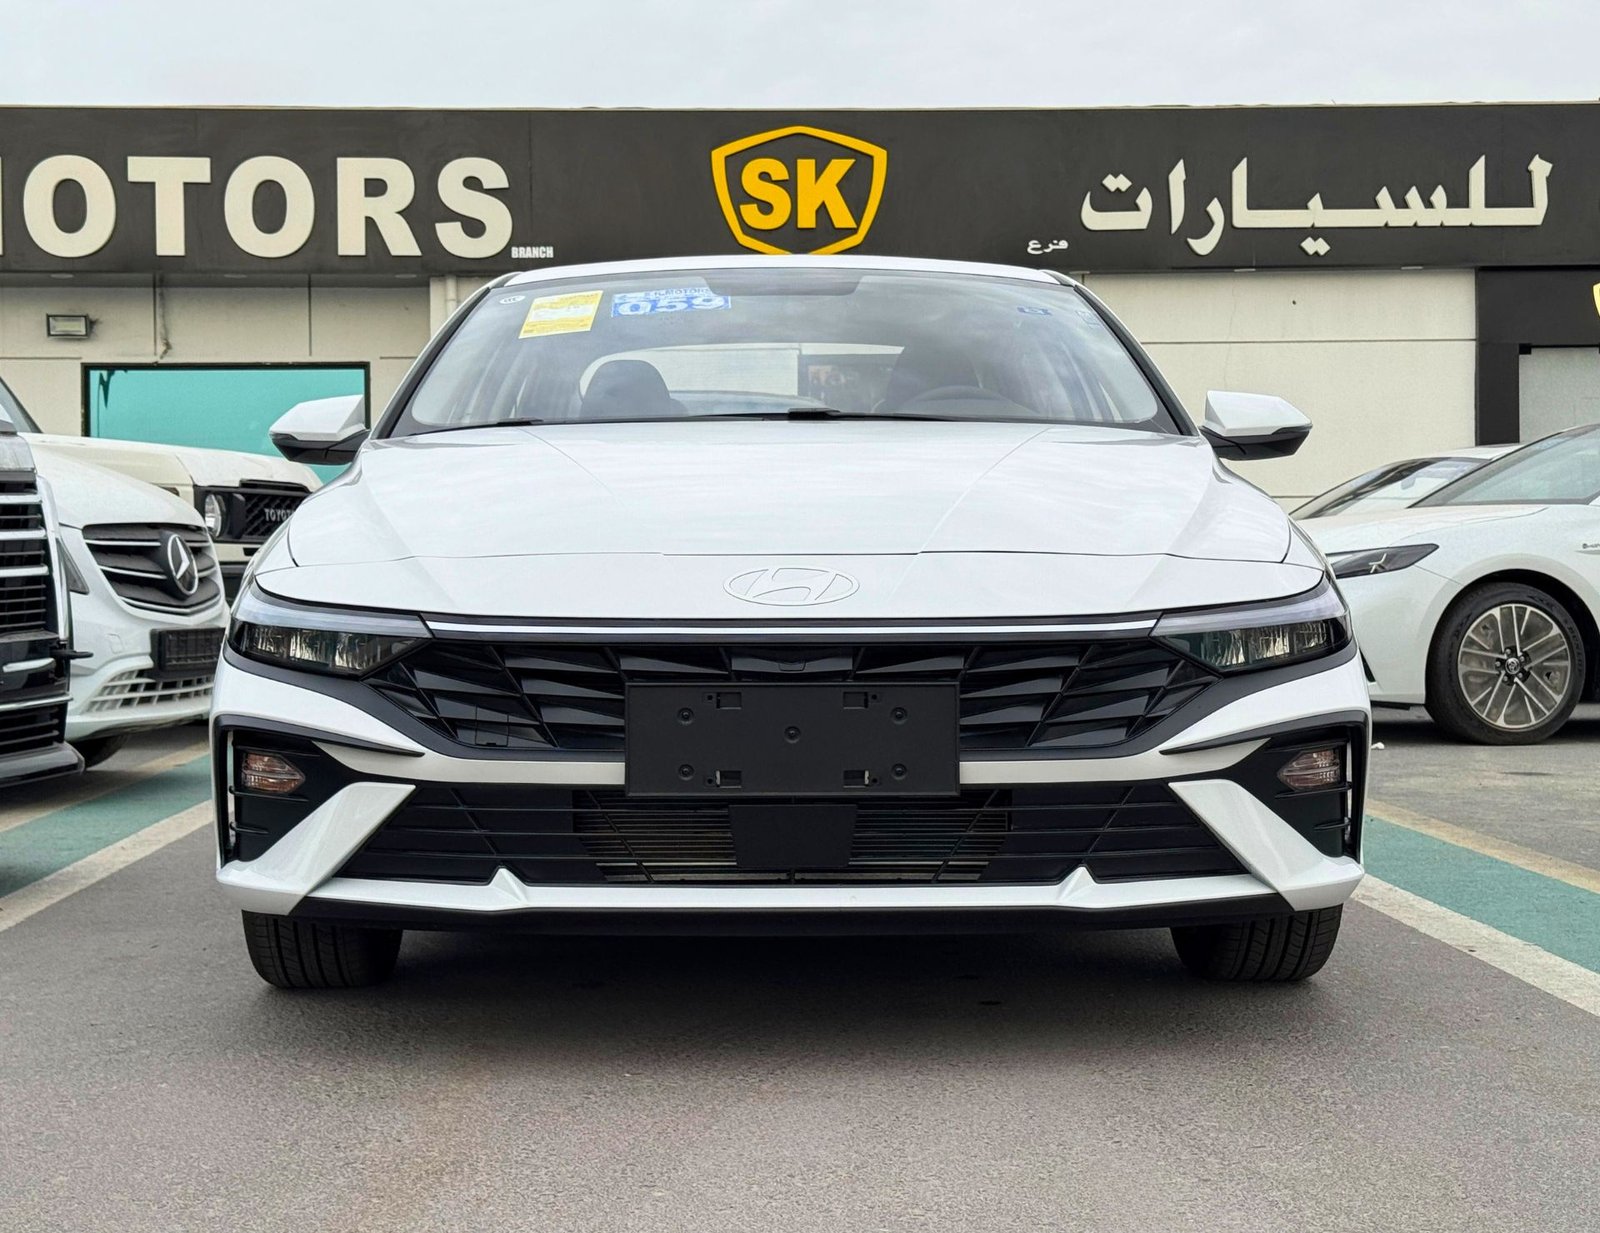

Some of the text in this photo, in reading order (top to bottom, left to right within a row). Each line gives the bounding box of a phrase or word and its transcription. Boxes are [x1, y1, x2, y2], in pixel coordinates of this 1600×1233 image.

[0, 154, 514, 259] OTORS
[739, 157, 858, 230] SK
[1080, 153, 1553, 256] للسيارات
[511, 246, 554, 259] BRANCH
[1026, 239, 1069, 255] فرع
